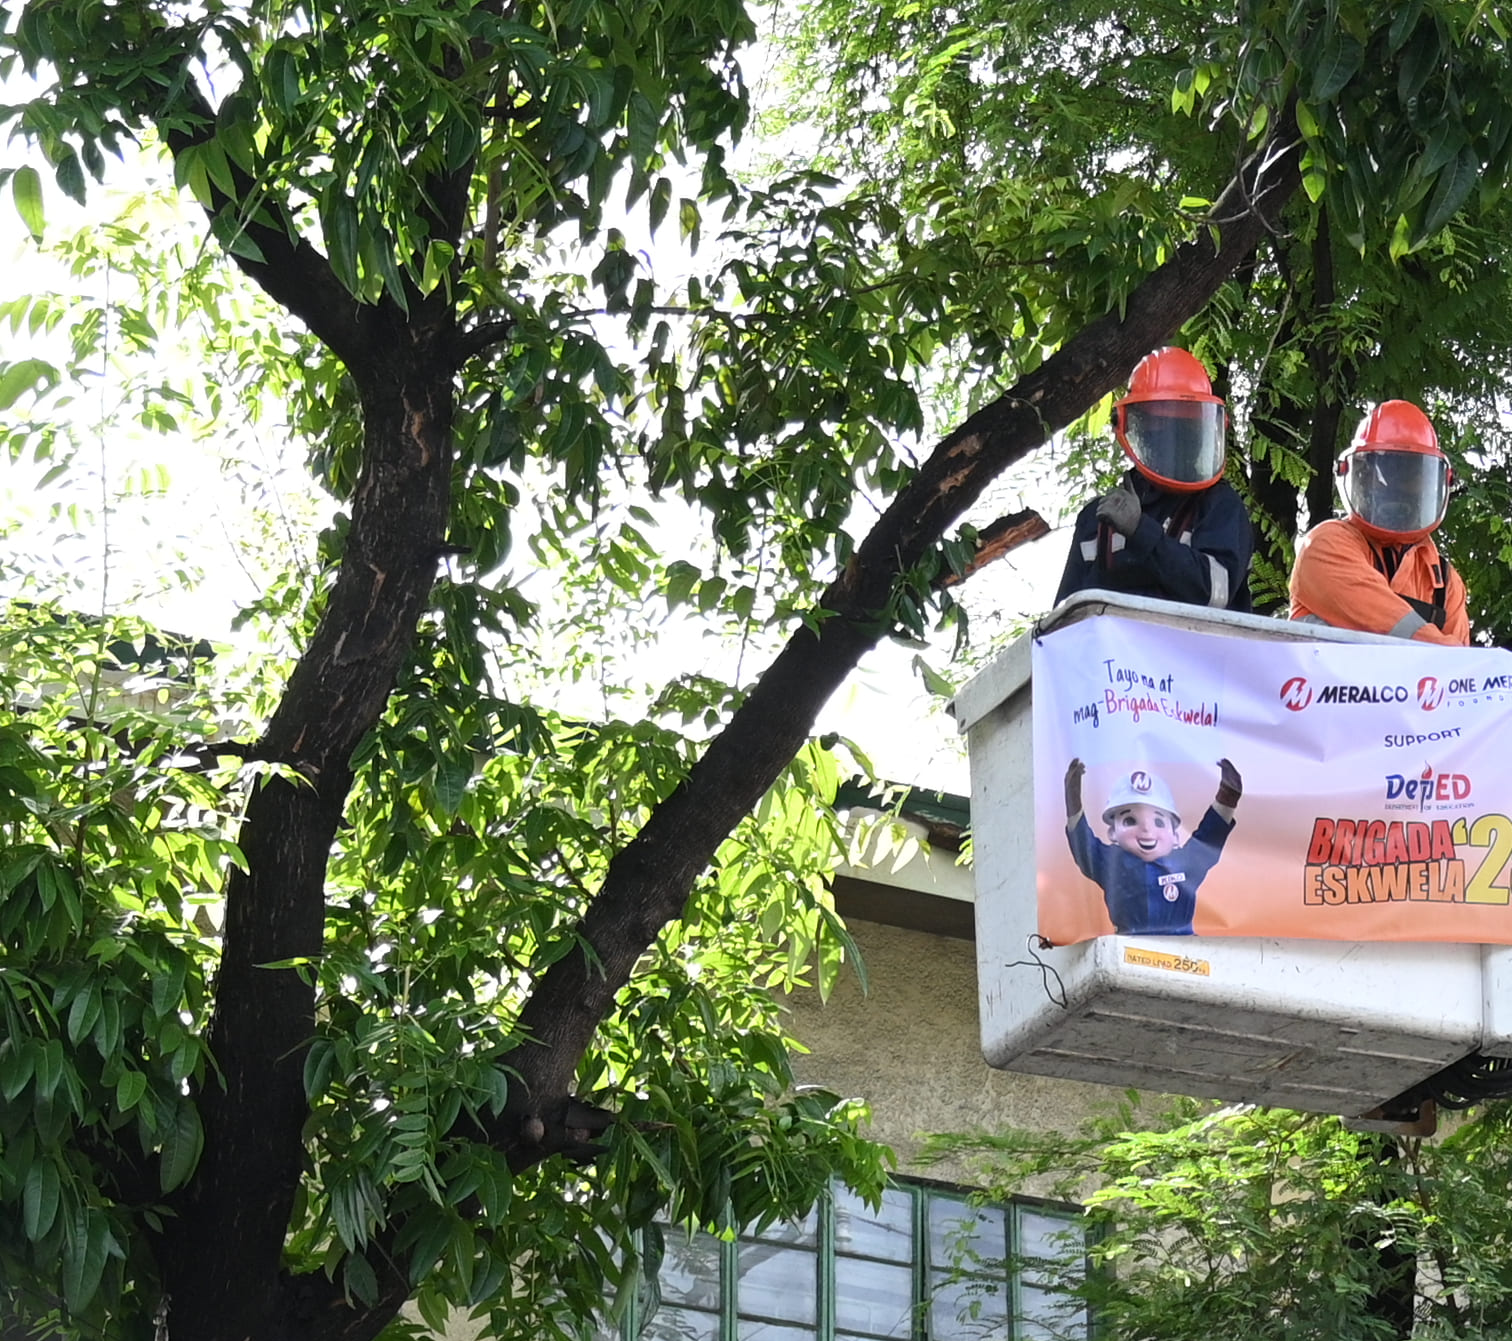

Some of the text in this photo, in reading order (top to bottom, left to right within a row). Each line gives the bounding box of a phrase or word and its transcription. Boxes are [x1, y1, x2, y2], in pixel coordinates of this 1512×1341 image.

[1103, 659, 1174, 693] Tayo na at
[1448, 678, 1477, 694] ONE
[1316, 685, 1409, 704] MERALCO
[1383, 727, 1463, 748] SUPPORT
[1306, 817, 1456, 866] BRIGADA
[1304, 859, 1465, 906] ESKWELA
